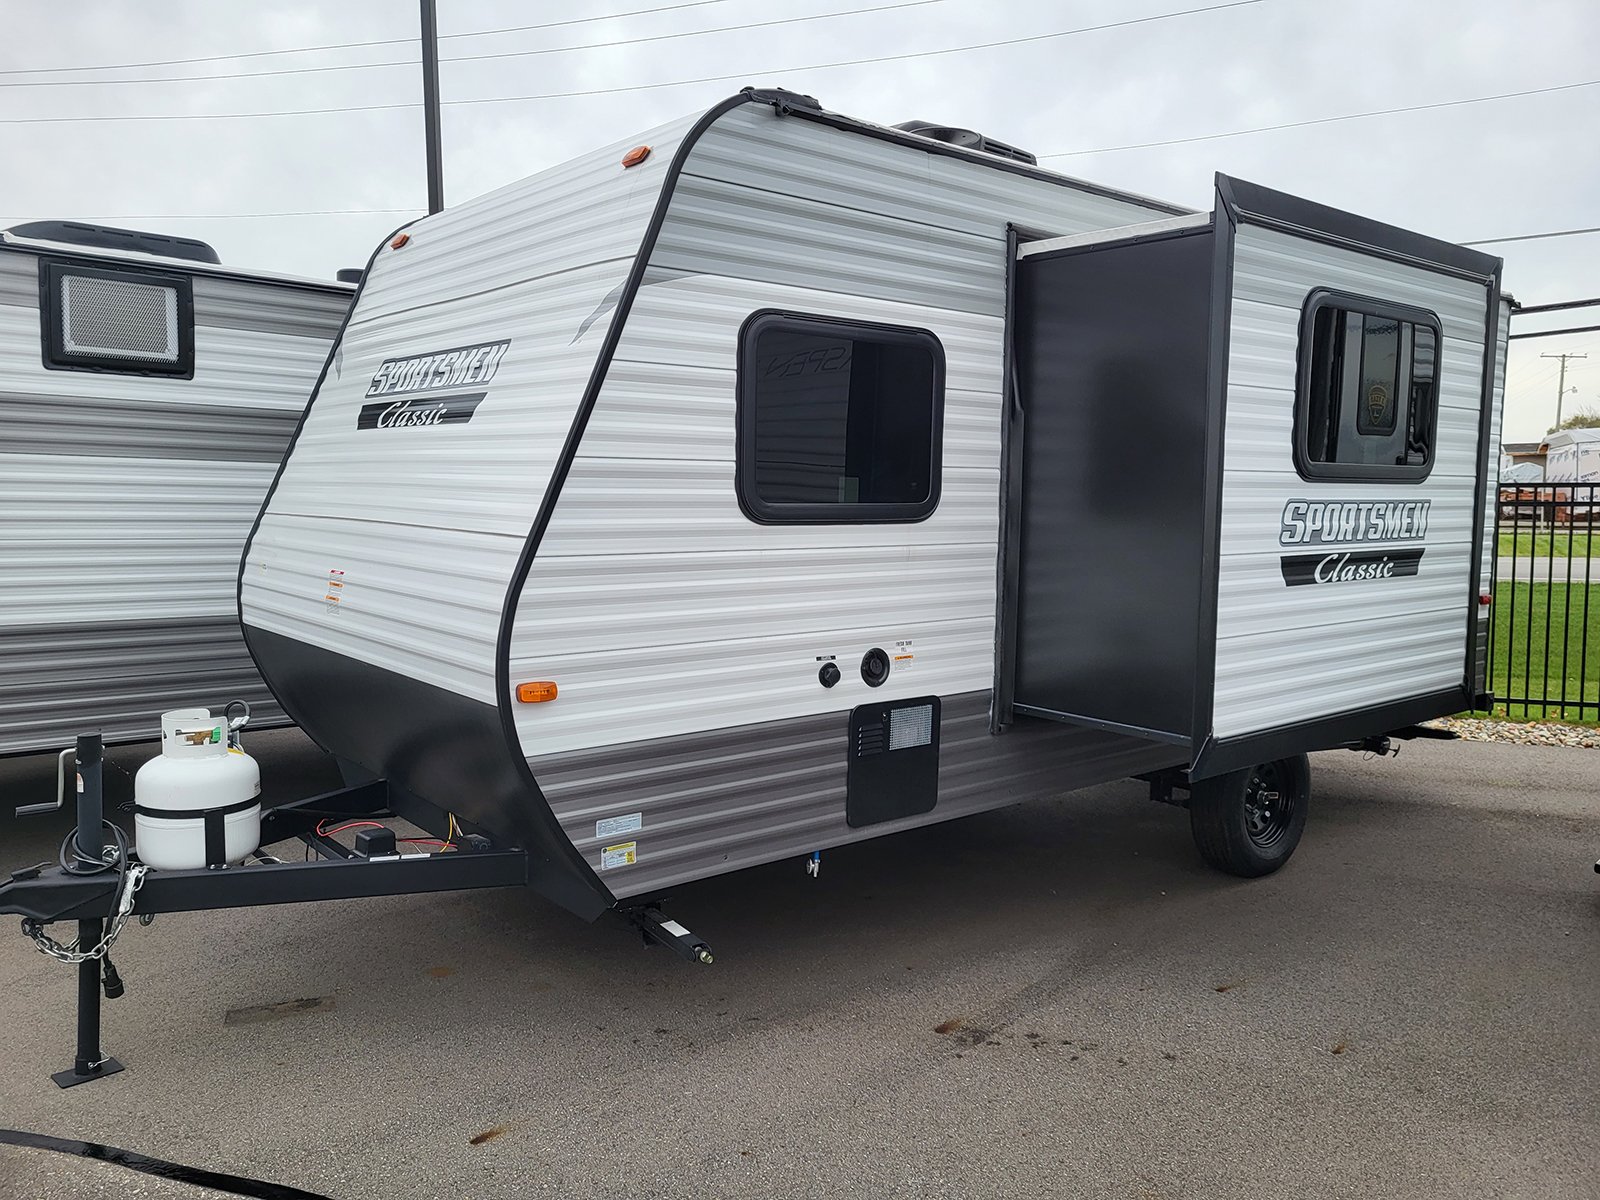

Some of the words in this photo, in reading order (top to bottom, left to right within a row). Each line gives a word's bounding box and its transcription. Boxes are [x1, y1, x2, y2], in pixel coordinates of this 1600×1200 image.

[367, 342, 510, 396] SPORTSMEN
[377, 401, 447, 428] Classic
[1280, 501, 1430, 544] SPORTSMEN
[1314, 553, 1394, 584] Classic
